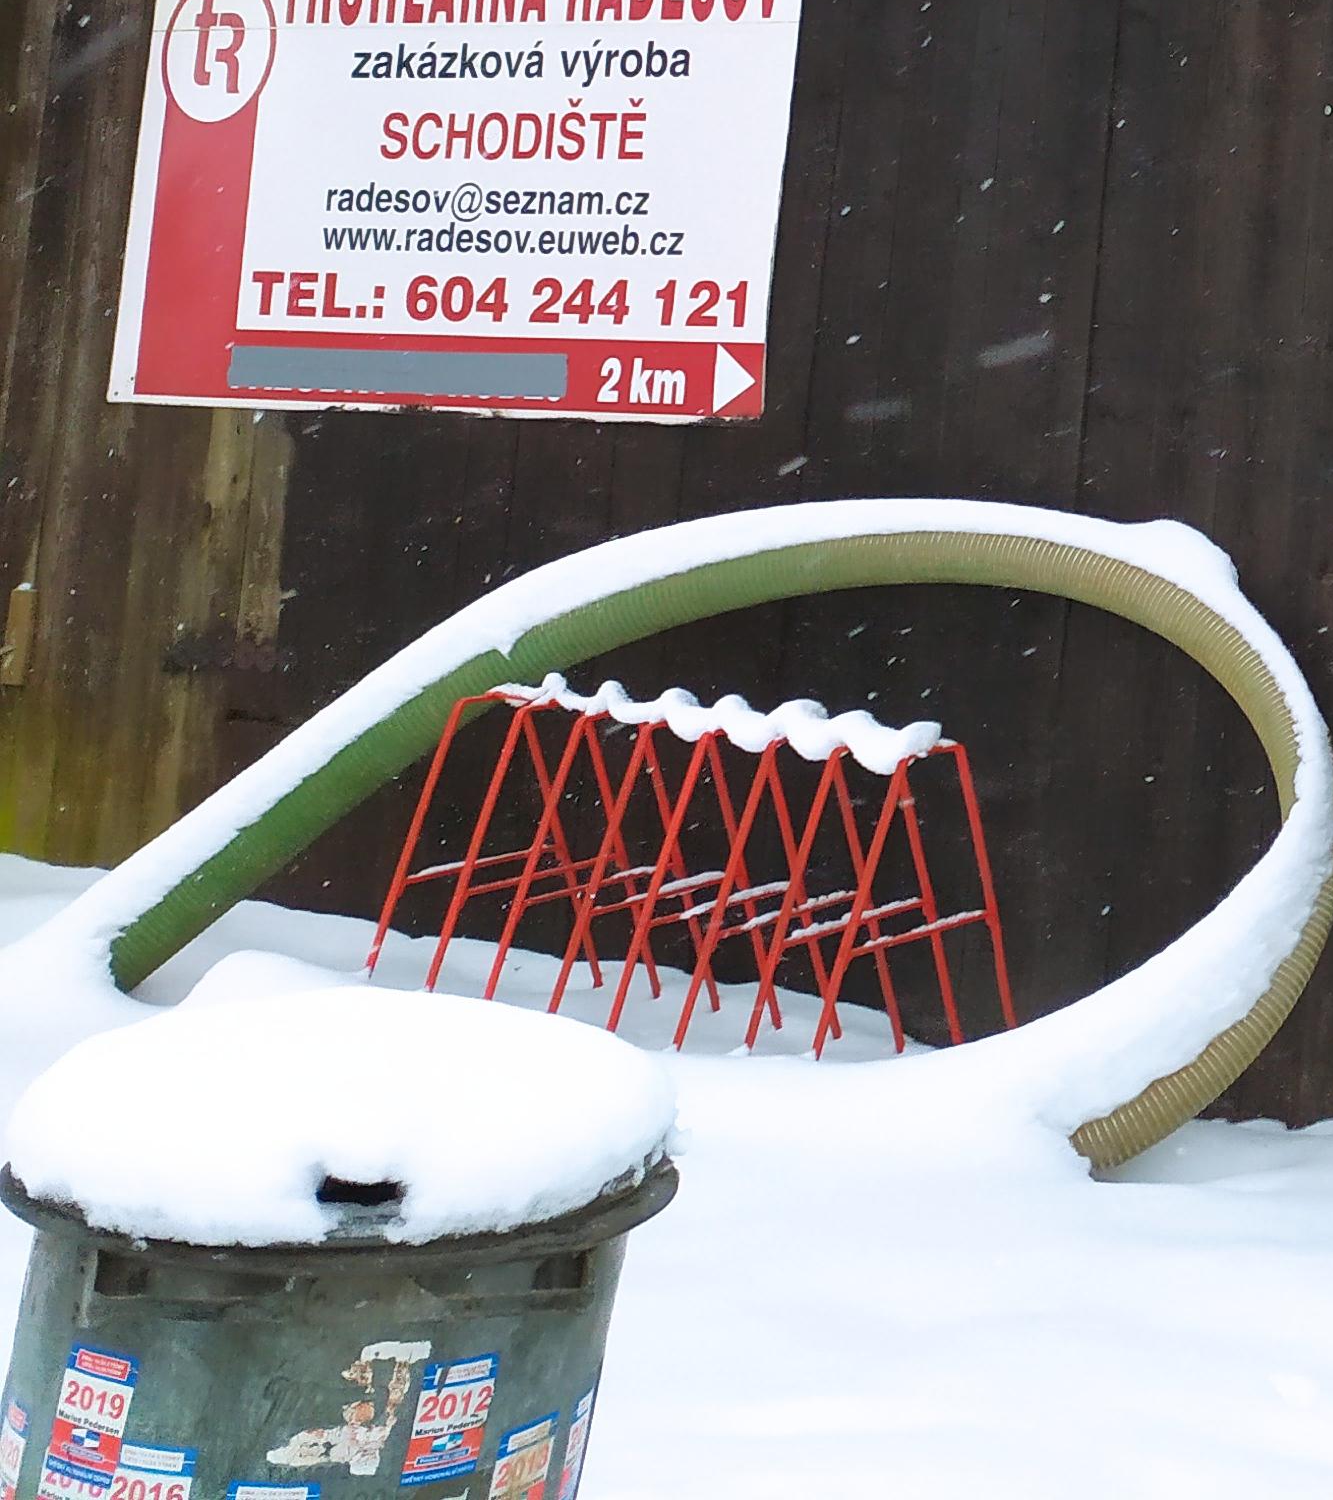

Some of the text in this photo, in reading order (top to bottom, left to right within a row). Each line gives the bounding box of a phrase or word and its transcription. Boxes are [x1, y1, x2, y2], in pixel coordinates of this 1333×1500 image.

[350, 40, 691, 87] zakázková výroba
[381, 98, 648, 162] SCHODIŠTĚ
[326, 183, 650, 222] radesov@seznam.cz
[323, 222, 685, 257] www.radesov.euweb.cz
[252, 271, 749, 329] TEL.: 604 244 121
[596, 359, 624, 403] 2
[630, 357, 687, 406] km
[63, 1380, 125, 1420] 2019
[418, 1385, 494, 1423] 2012
